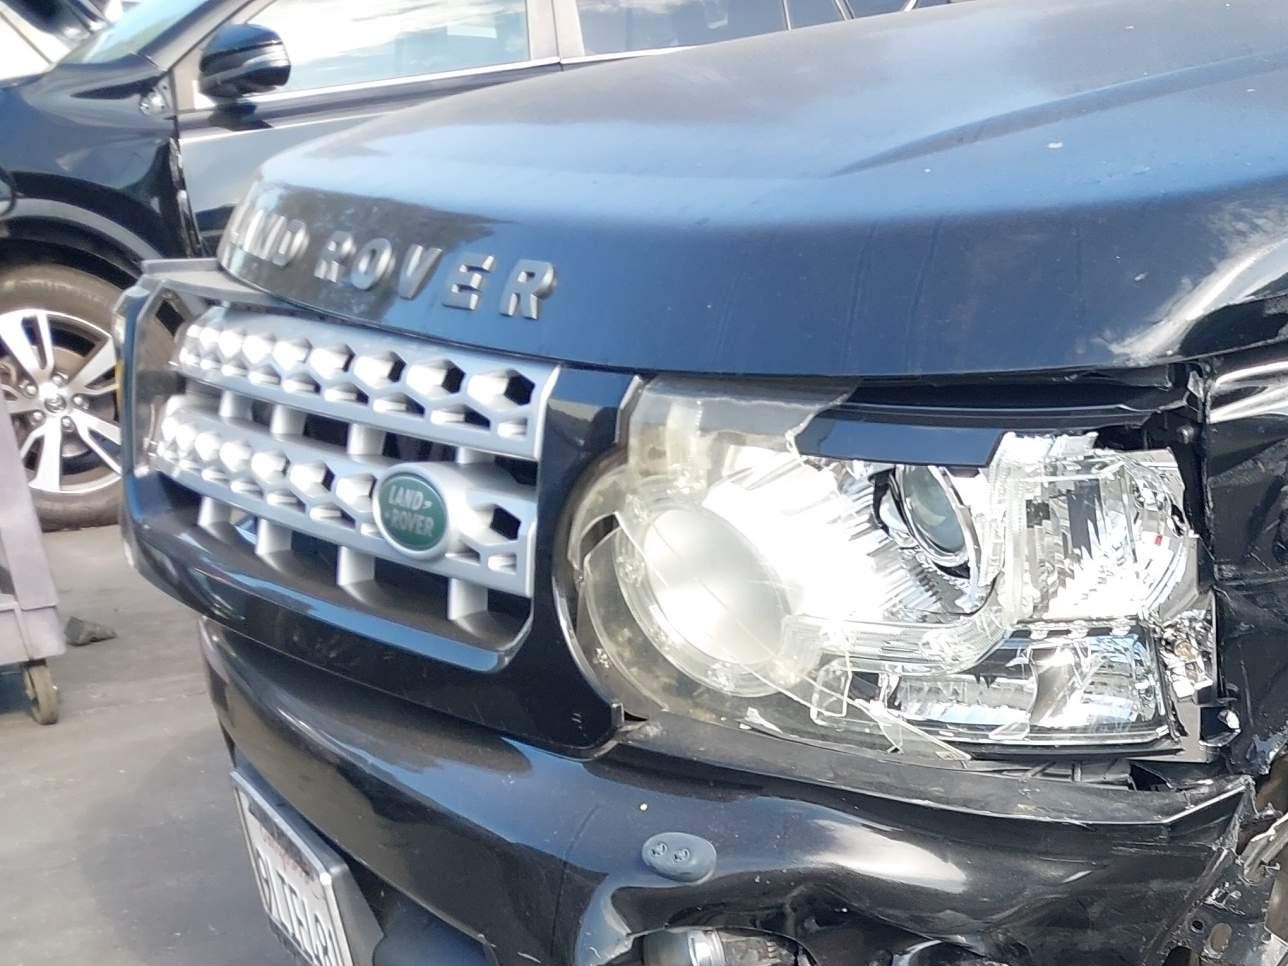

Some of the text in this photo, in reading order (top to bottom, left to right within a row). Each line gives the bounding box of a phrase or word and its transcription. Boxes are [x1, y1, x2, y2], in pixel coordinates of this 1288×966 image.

[313, 230, 557, 320] ROVER
[388, 484, 424, 511] LAND
[391, 507, 435, 537] ROVER
